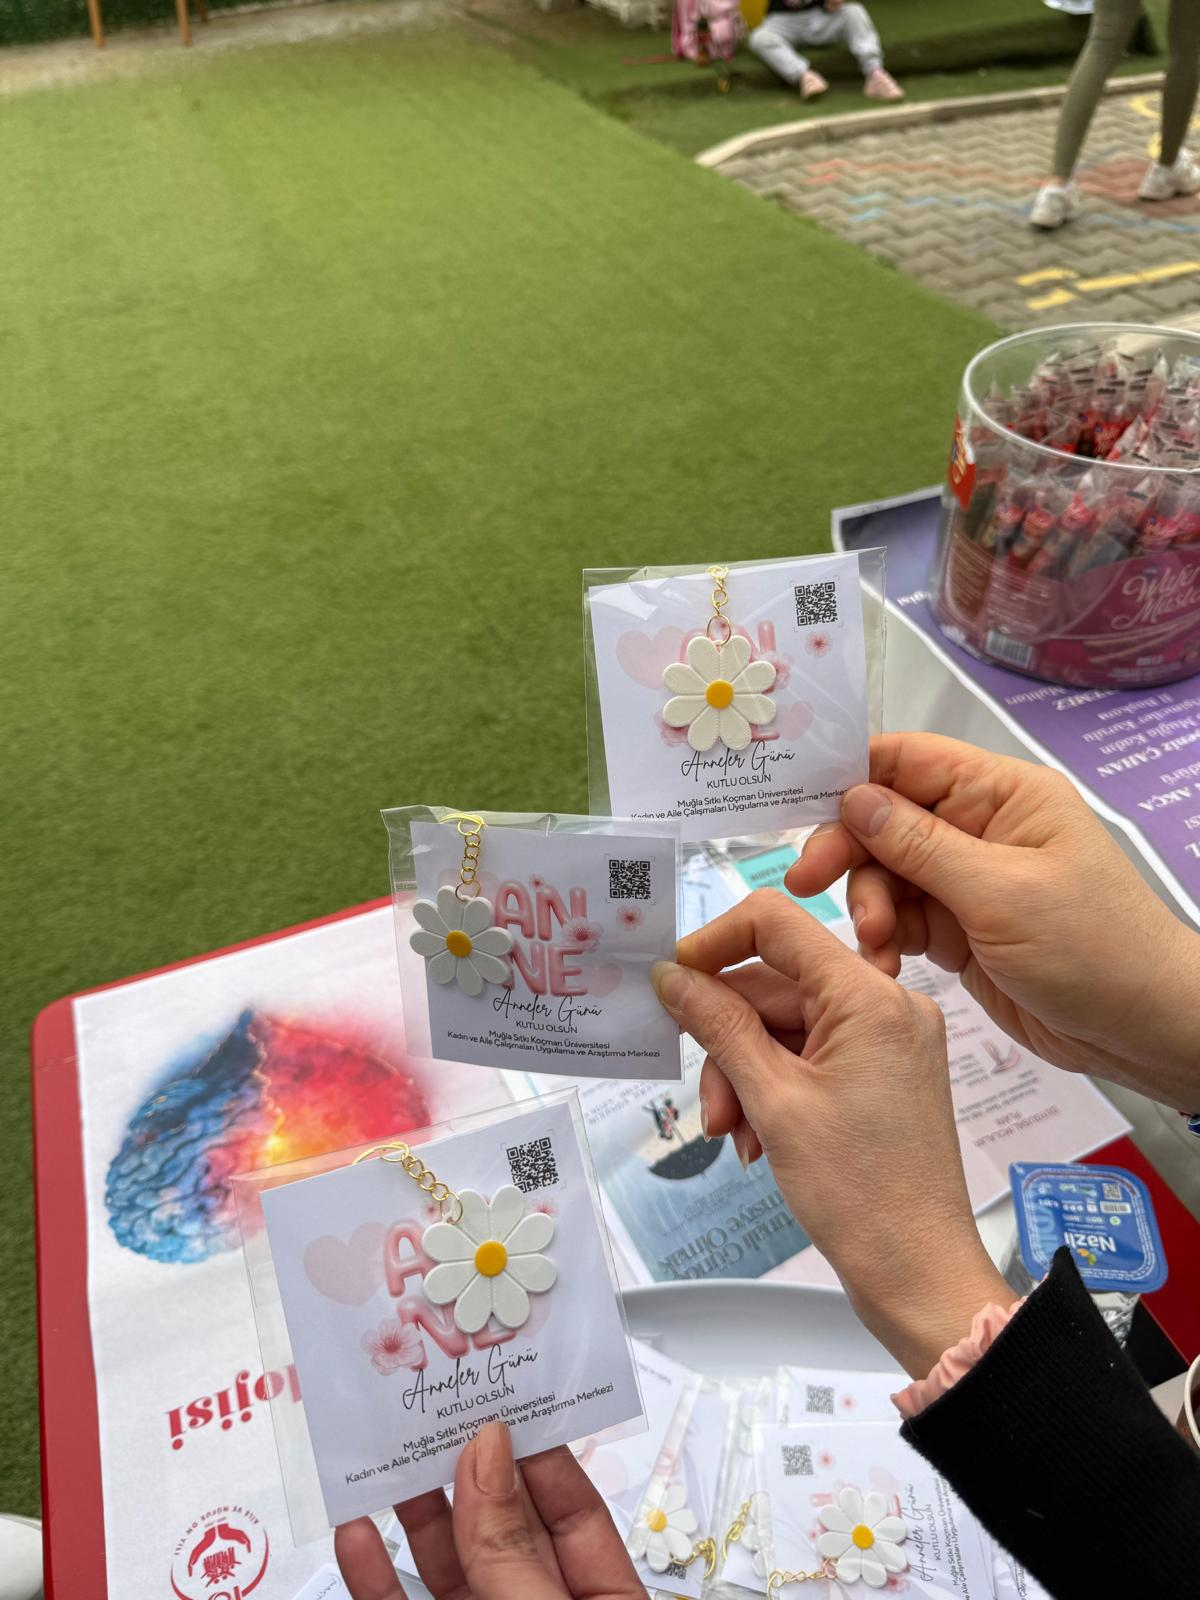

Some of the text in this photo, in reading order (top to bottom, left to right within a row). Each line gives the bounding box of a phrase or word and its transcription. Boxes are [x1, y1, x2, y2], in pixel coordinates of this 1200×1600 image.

[752, 740, 796, 775] Günü
[677, 786, 804, 809] Muğla Sıtkı Koçman Üniversitesi
[706, 773, 772, 790] KUTLU OLSUN
[667, 809, 682, 818] Aile
[683, 805, 727, 817] Çalışmaları
[728, 800, 769, 813] Uygulama
[781, 794, 819, 805] Araştırma
[820, 789, 848, 800] Merke
[493, 987, 602, 1027] Anneler Günü
[488, 1030, 512, 1041] Muğla
[530, 1035, 563, 1047] Koçman
[564, 1038, 610, 1049] Üniversitesi
[515, 1020, 578, 1034] KUTLU OLSUN
[447, 1030, 469, 1041] Kadın
[479, 1036, 493, 1046] Aile
[494, 1039, 535, 1051] Çalışmaları
[535, 1044, 576, 1055] Uygulama
[587, 1049, 626, 1058] Araştırma
[627, 1049, 660, 1058] Merkezi
[402, 1343, 538, 1413] Anneler Günü
[436, 1384, 515, 1419] KUTLU OLSUN
[345, 1468, 376, 1484] Kadın
[377, 1462, 390, 1473] ve
[391, 1455, 411, 1469] Aile
[411, 1436, 466, 1462] Çalışmaları
[516, 1414, 530, 1424] ve
[531, 1398, 576, 1419] Araştırma
[576, 1381, 614, 1403] Merkezi
[403, 1391, 556, 1453] Muğla Sıtkı Koçman Üniversitesi
